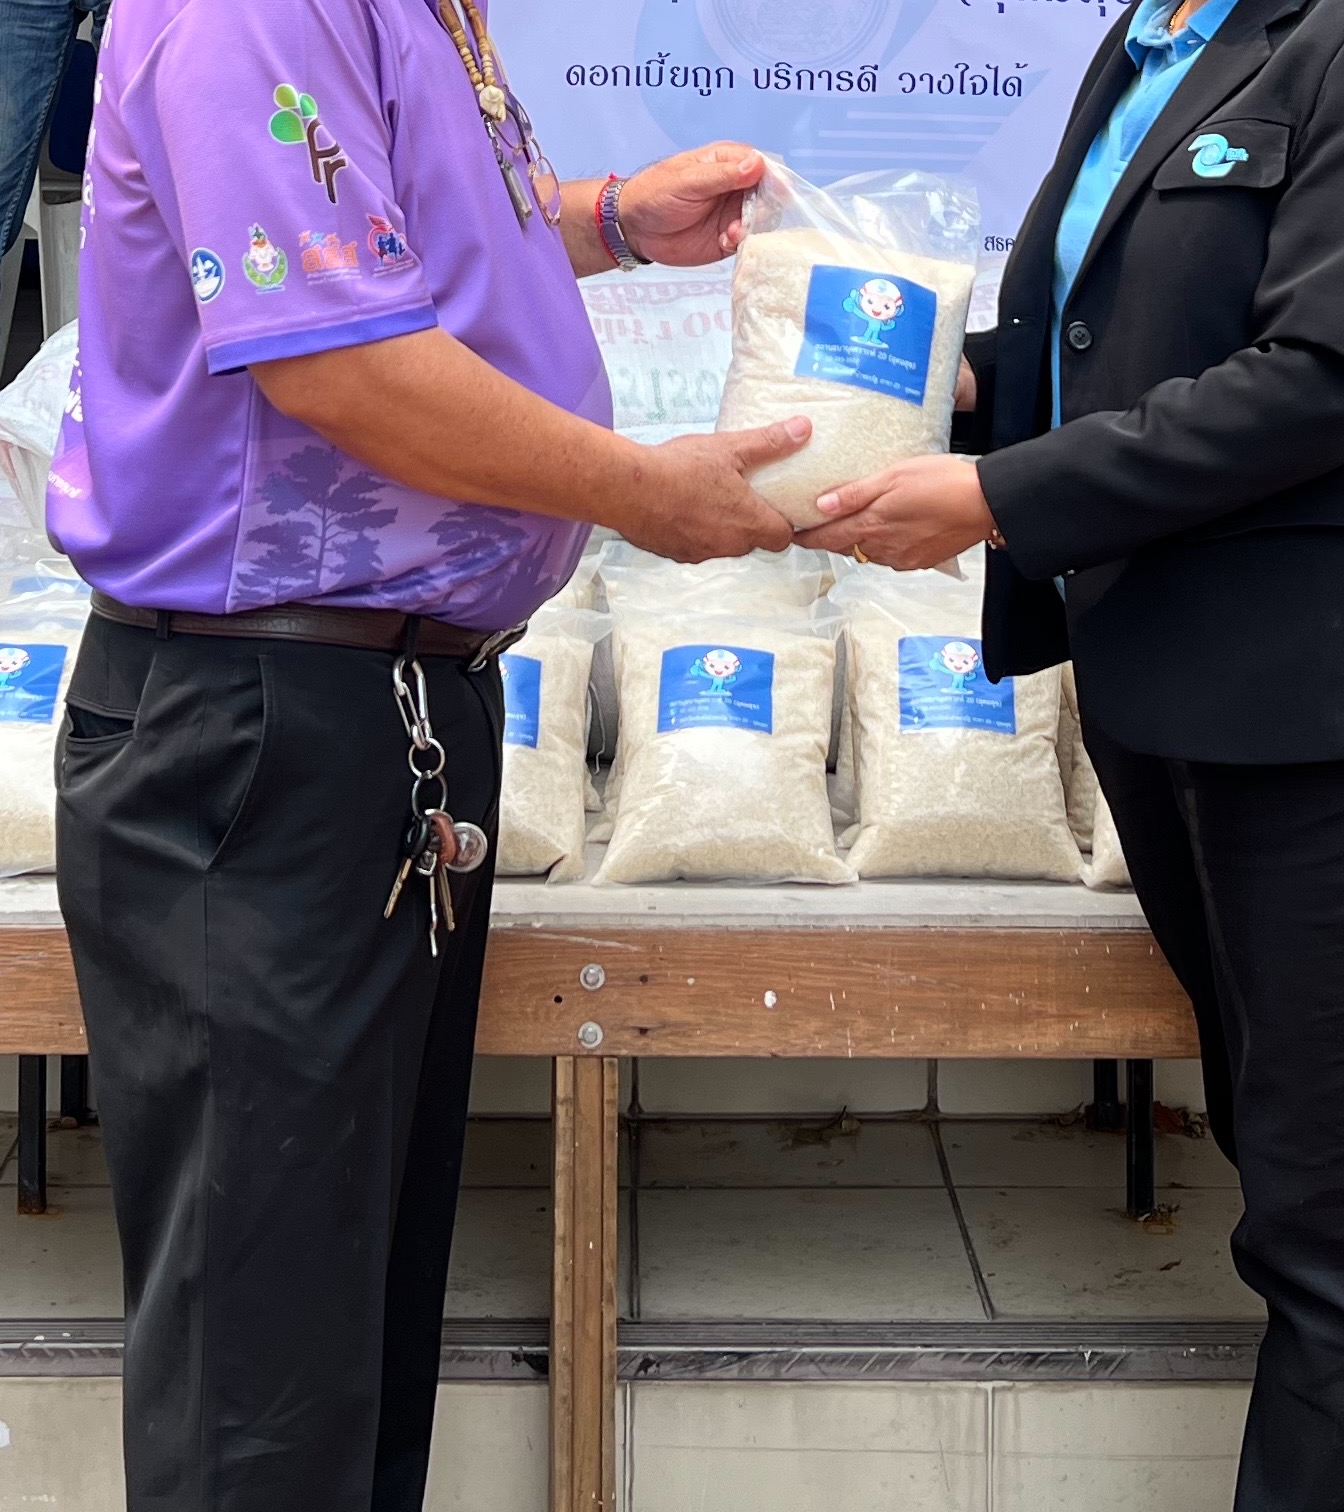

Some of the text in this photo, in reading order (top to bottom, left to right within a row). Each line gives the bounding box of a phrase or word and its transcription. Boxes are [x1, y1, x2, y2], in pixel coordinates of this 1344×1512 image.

[565, 51, 1029, 99] ดอกเบี้ยถูก บริการดี วางใจได้
